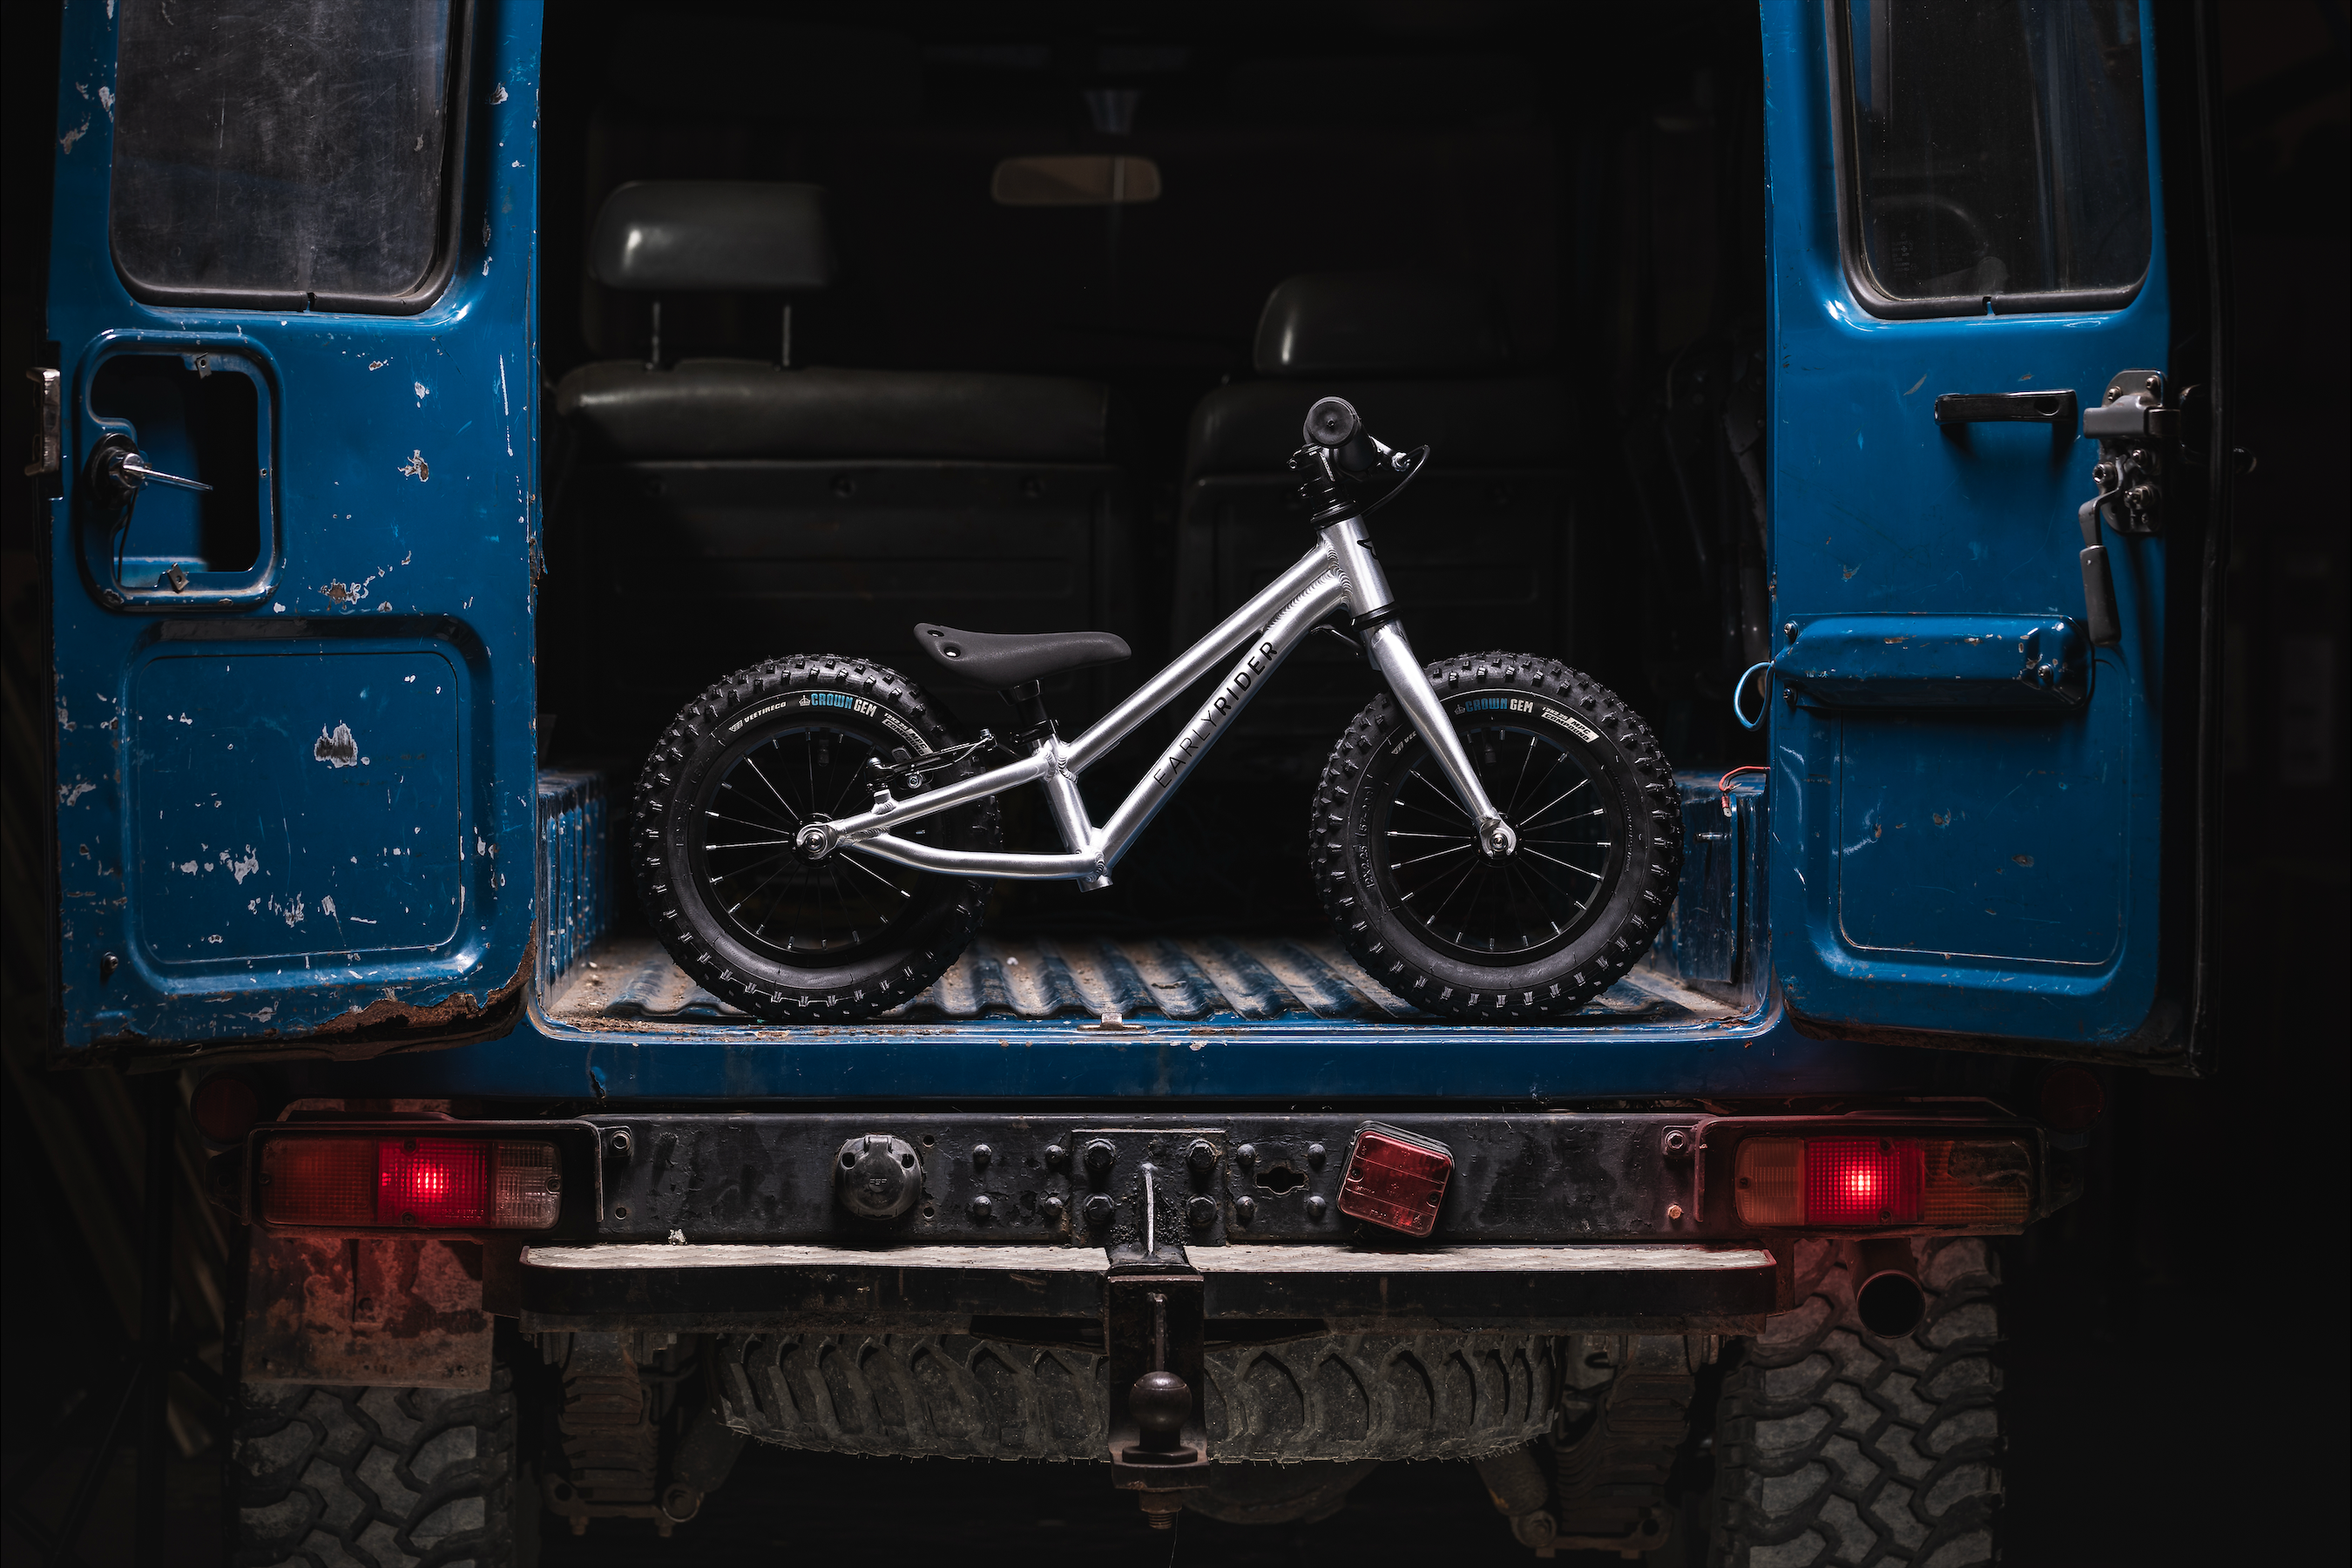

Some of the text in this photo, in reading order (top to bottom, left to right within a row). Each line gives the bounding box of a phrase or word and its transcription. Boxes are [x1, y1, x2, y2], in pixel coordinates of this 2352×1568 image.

[811, 693, 877, 717] CROWN GEM
[1465, 698, 1534, 713] CROWN GEM
[1544, 713, 1590, 740] COMPOUND
[1571, 720, 1591, 734] MPC
[886, 720, 925, 756] COMPOUND
[909, 733, 928, 749] MPC
